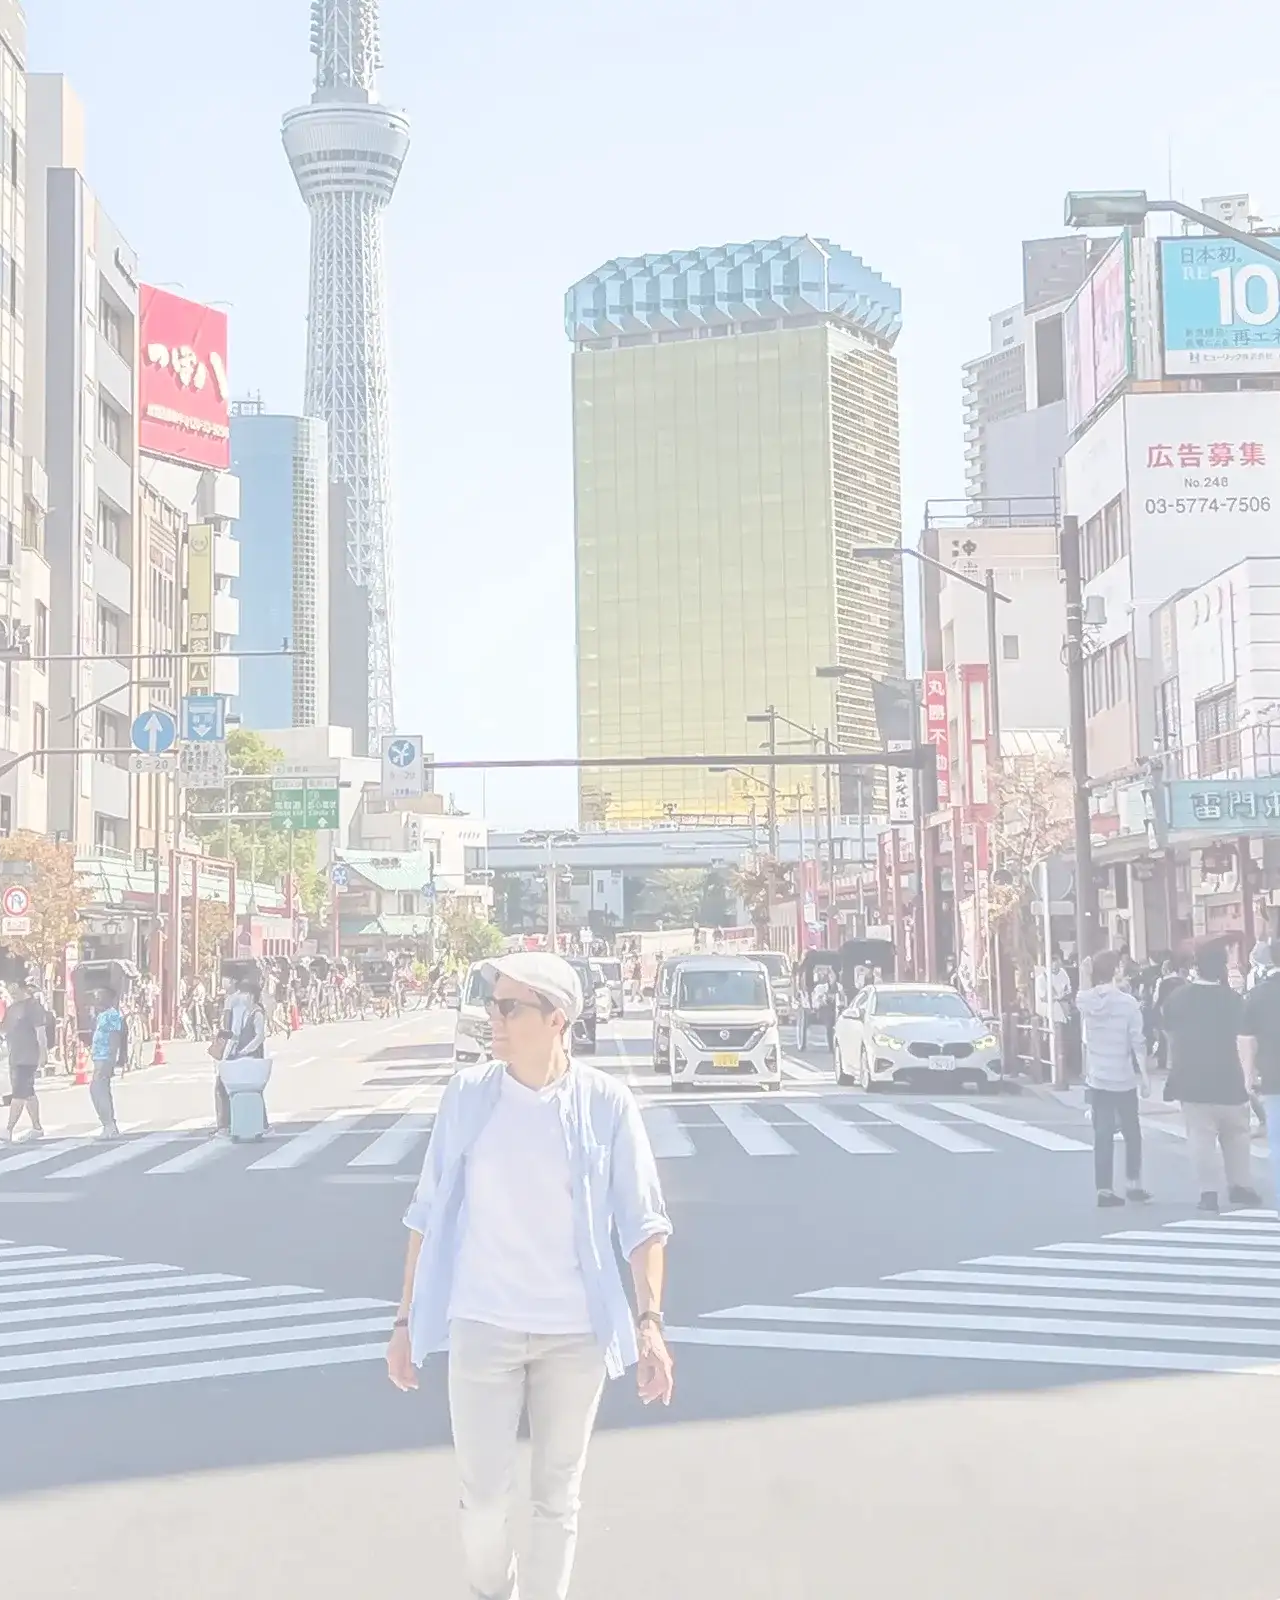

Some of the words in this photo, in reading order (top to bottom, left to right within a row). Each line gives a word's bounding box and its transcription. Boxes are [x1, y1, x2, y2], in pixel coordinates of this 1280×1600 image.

[1146, 442, 1267, 468] 広告募集
[1145, 496, 1271, 514] 03-5774-7506
